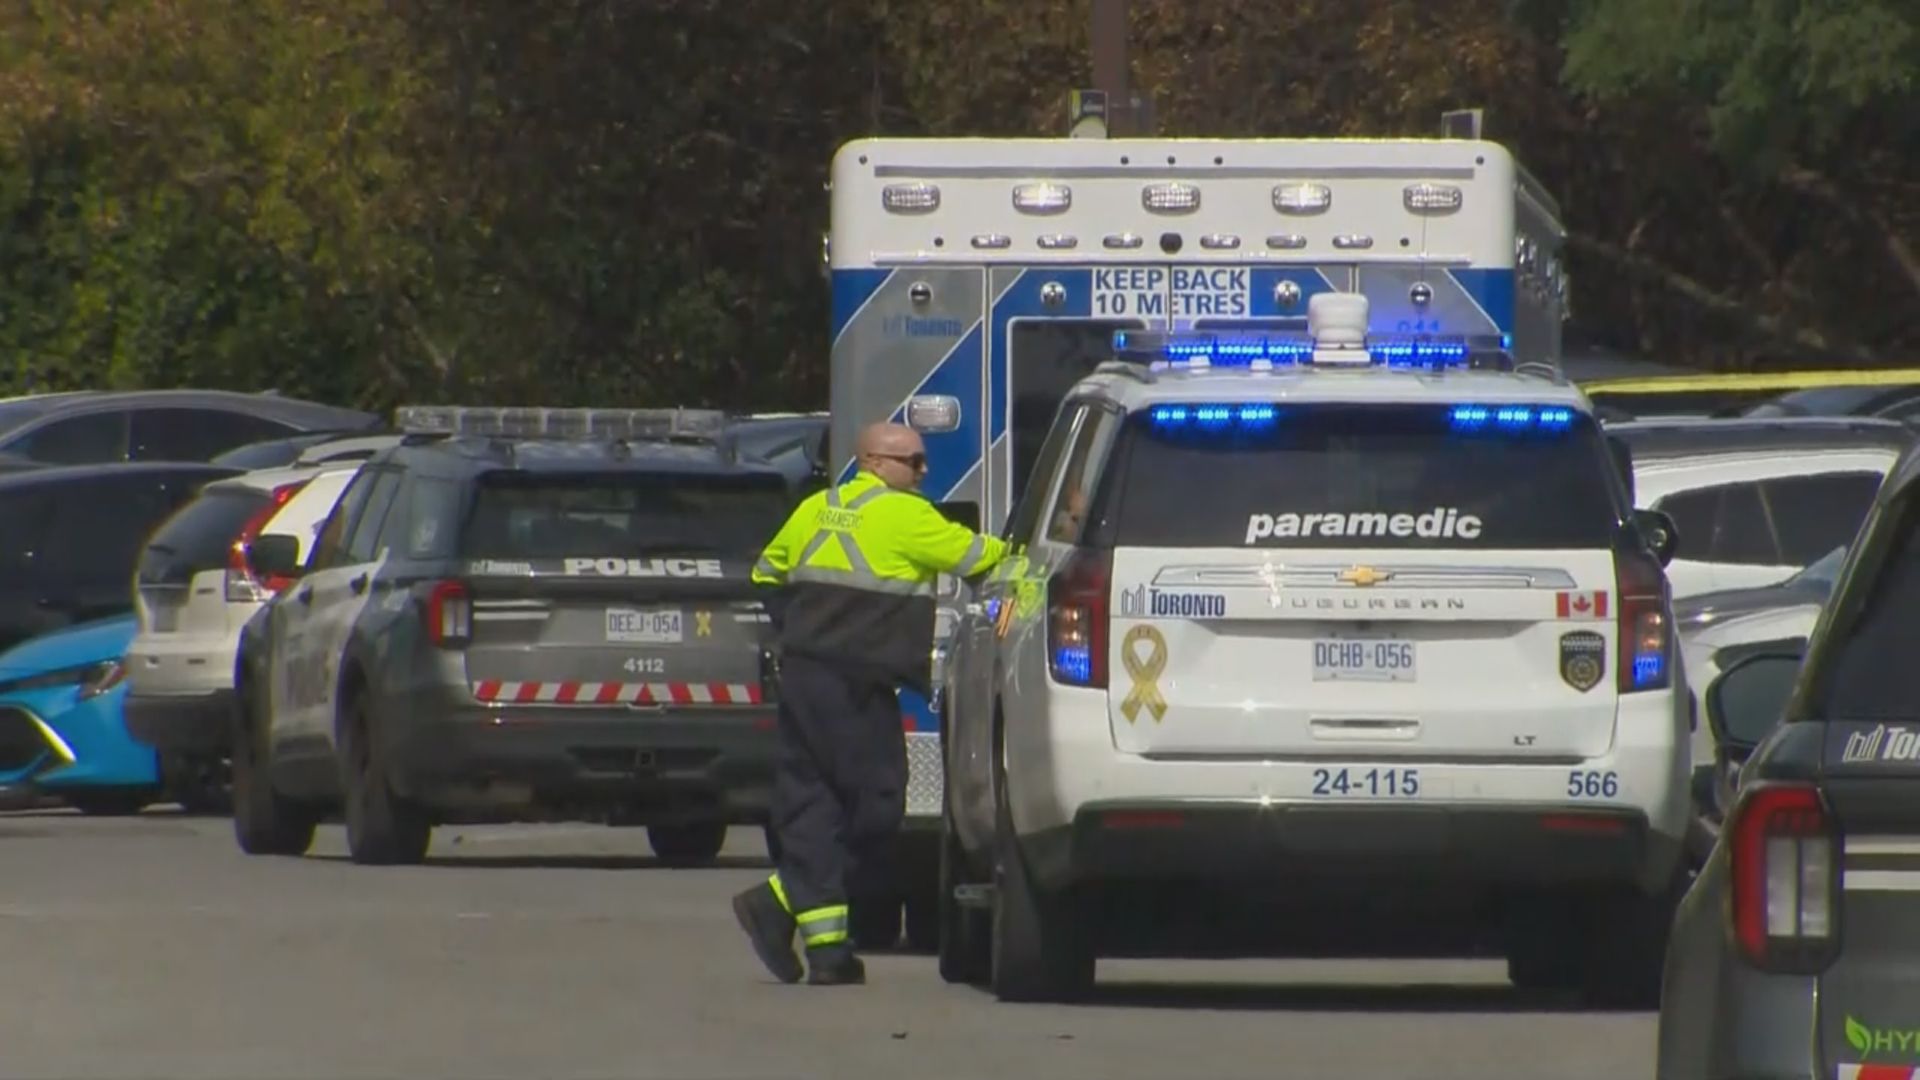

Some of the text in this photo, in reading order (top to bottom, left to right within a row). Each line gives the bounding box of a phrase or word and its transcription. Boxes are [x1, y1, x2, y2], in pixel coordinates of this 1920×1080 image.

[1095, 268, 1247, 292] KEEP BACK
[1095, 292, 1246, 316] 10 METRES
[1245, 507, 1482, 545] paramedic
[563, 558, 723, 578] POLICE
[1150, 588, 1226, 617] TORONTO
[623, 658, 664, 673] 4112
[1513, 735, 1536, 746] LT
[1312, 768, 1419, 796] 24-115
[1567, 770, 1619, 797] 566
